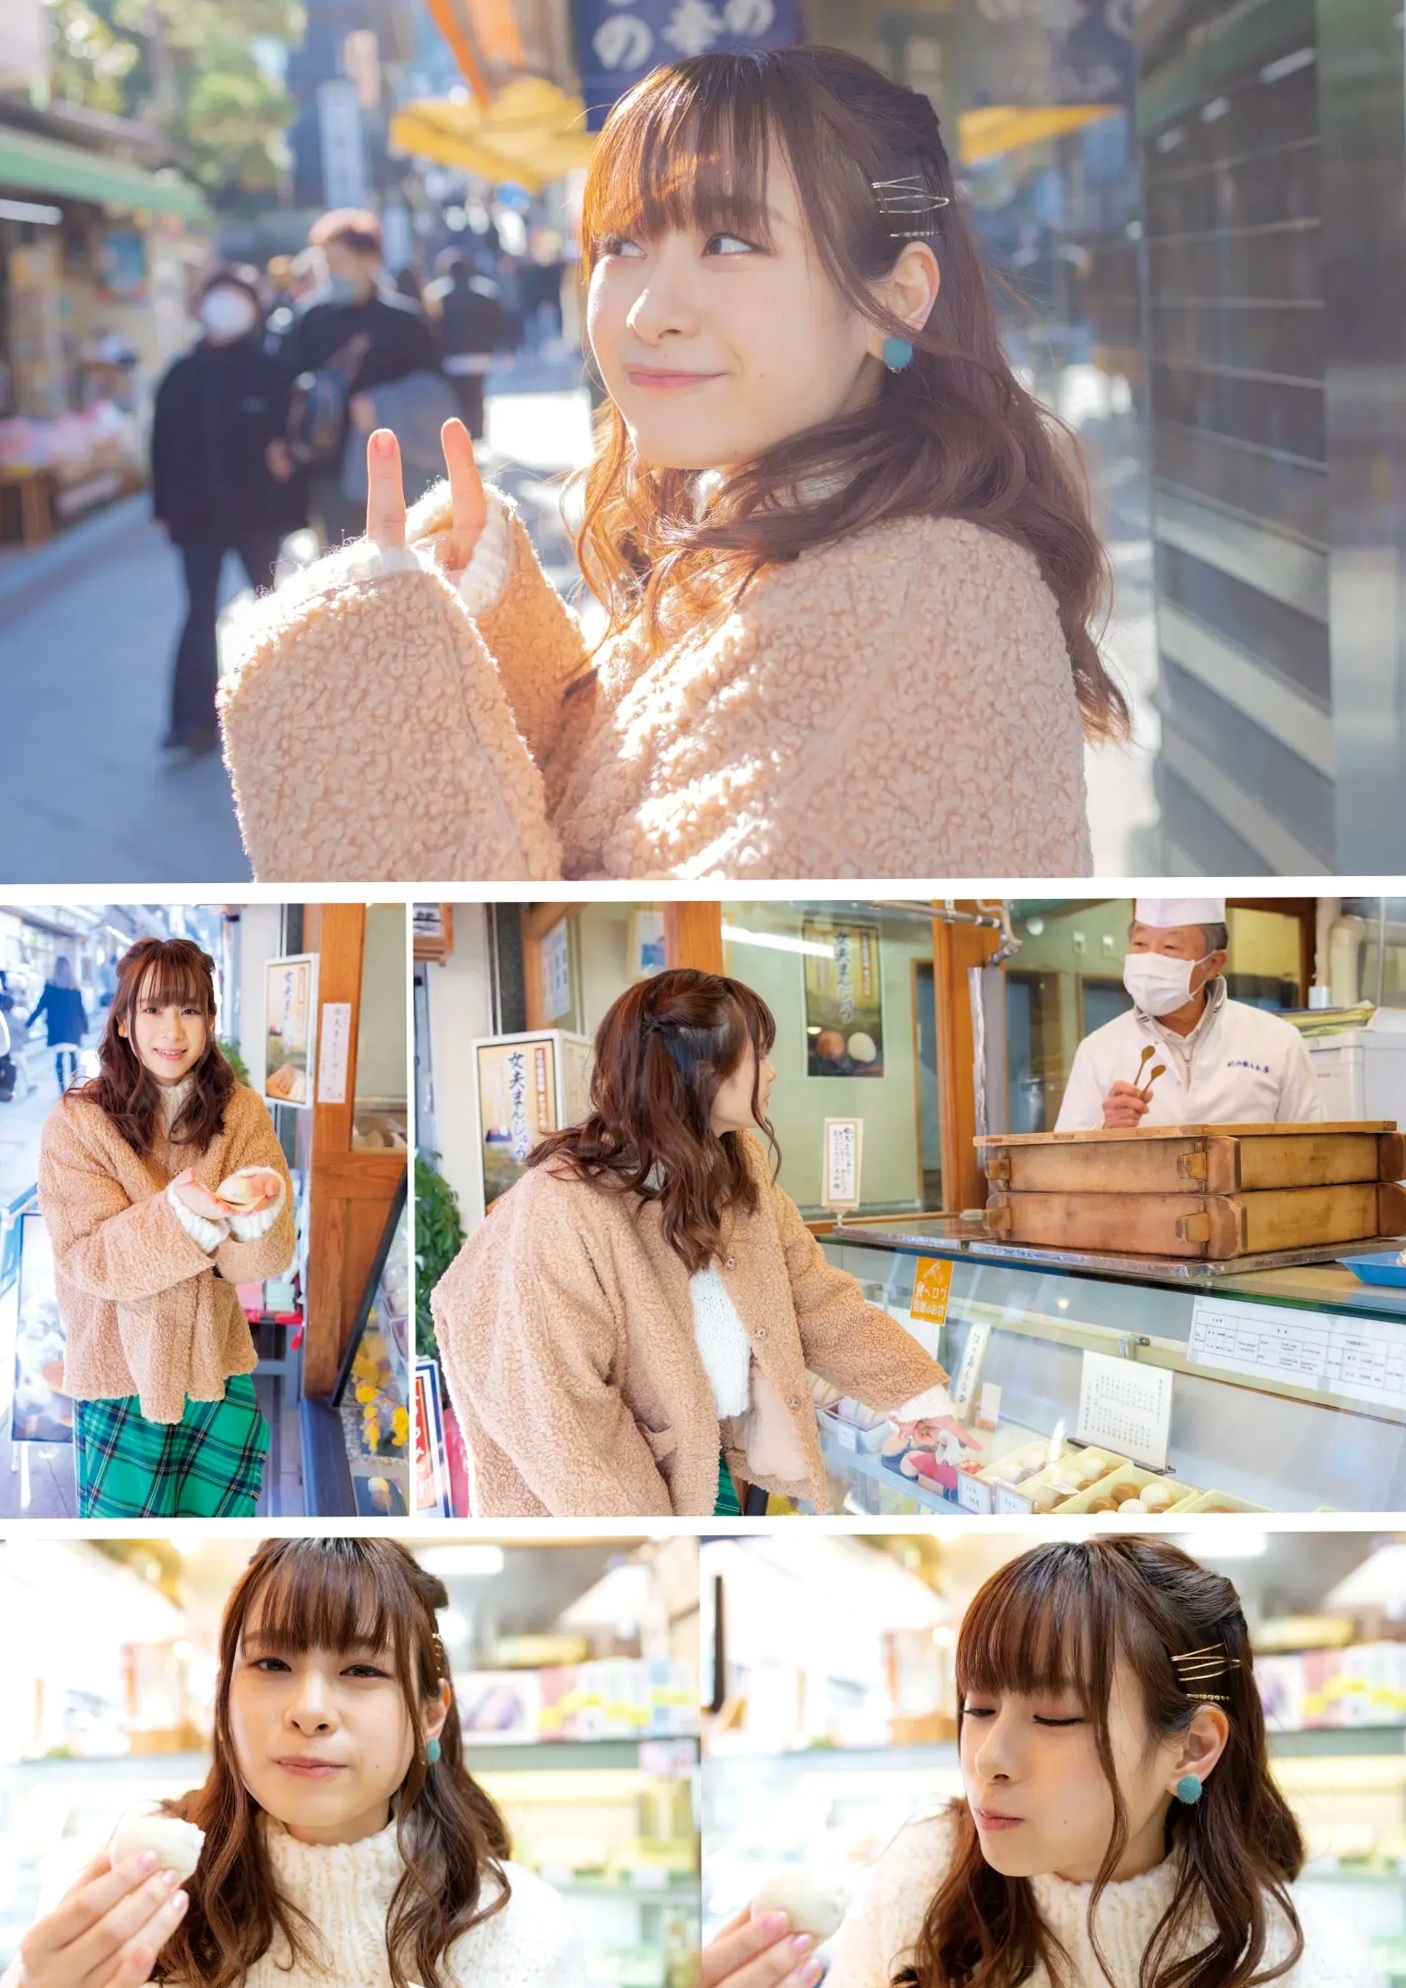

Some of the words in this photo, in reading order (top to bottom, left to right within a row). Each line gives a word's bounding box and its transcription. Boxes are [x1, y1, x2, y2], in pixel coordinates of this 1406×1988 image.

[508, 1050, 529, 1160] 女夫まんじゅう
[915, 1281, 949, 1301] 食べログ
